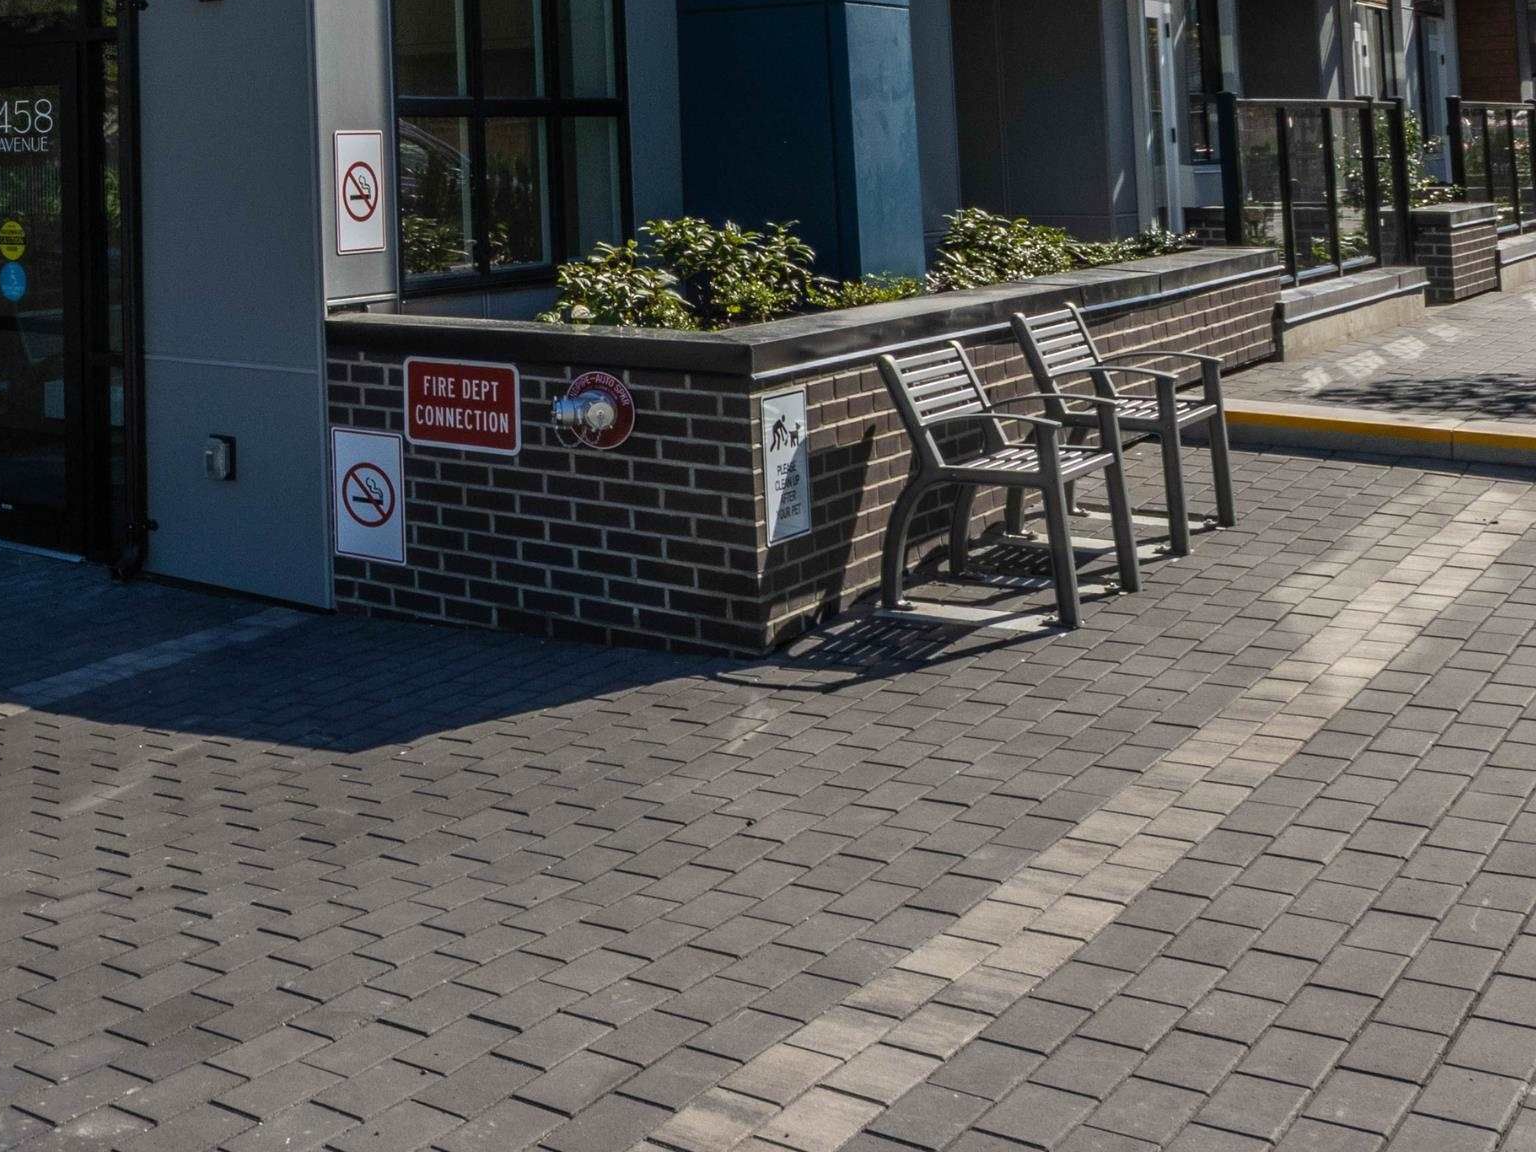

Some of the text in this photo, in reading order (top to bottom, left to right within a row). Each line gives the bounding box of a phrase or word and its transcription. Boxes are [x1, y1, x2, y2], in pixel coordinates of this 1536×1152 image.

[423, 375, 499, 402] FIRE DEPT
[415, 404, 509, 434] CONNECTION
[777, 462, 797, 476] PLEASE
[775, 475, 800, 491] CLEAN UP
[781, 490, 797, 504] AFTER
[776, 502, 801, 520] YOUR PET
